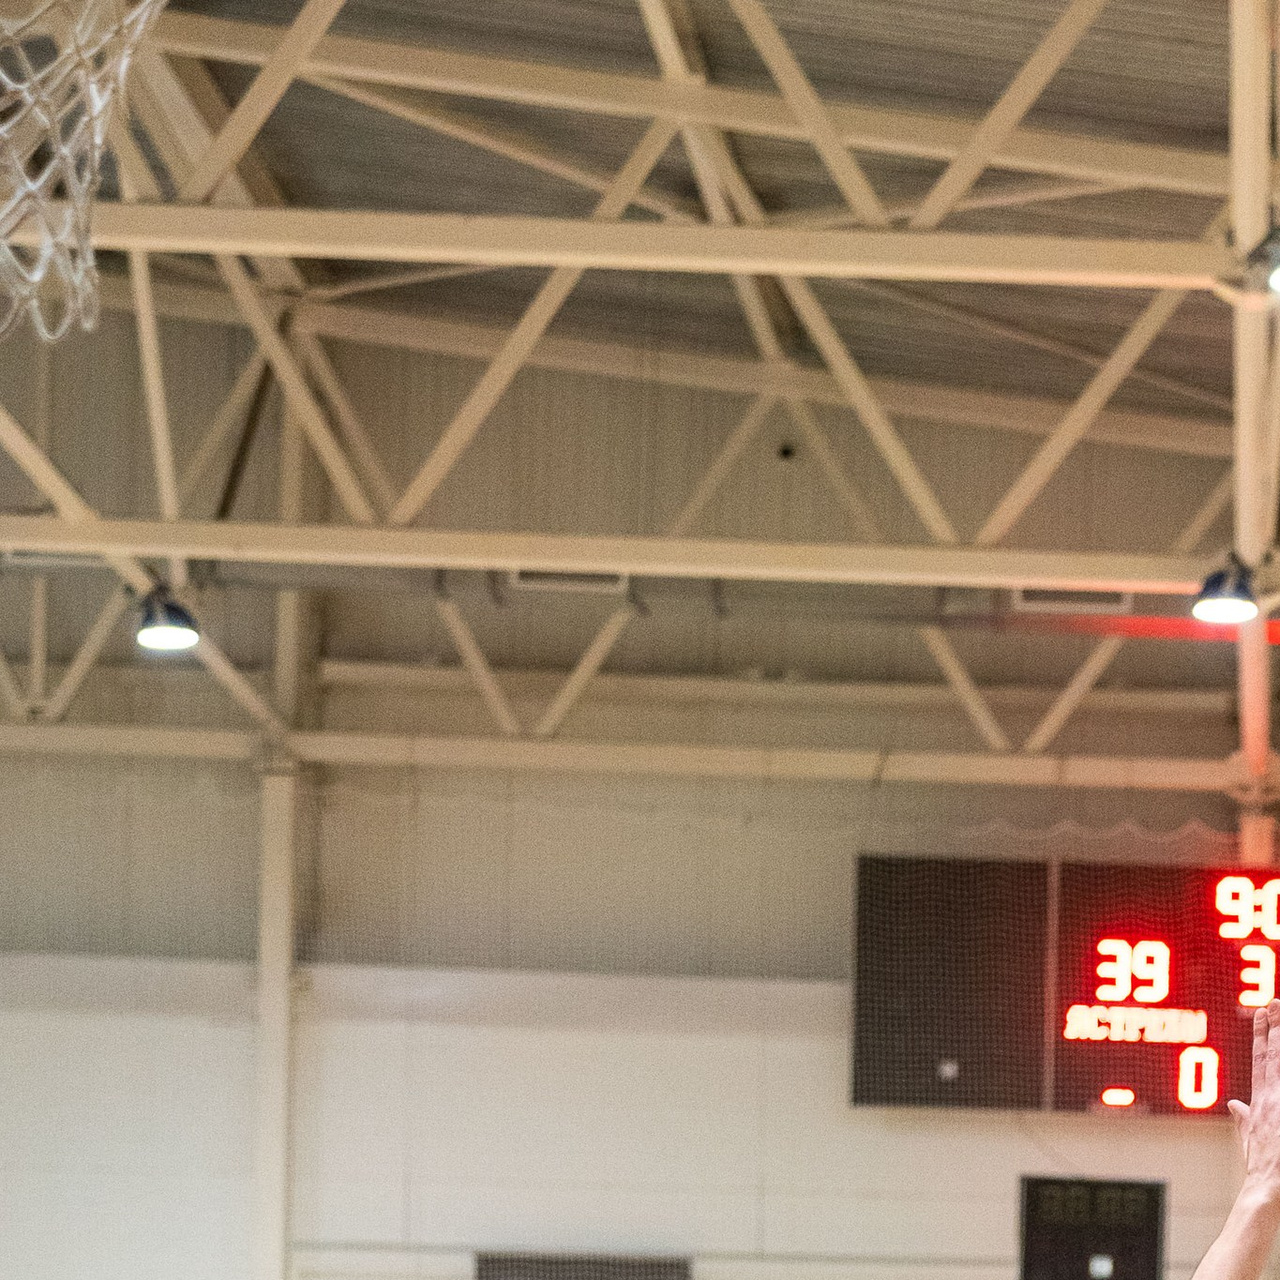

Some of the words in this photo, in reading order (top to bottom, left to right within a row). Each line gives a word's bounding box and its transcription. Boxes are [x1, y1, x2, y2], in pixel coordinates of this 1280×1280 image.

[1095, 938, 1171, 1004] 39
[1238, 945, 1277, 1007] 3
[1178, 1046, 1220, 1109] 0
